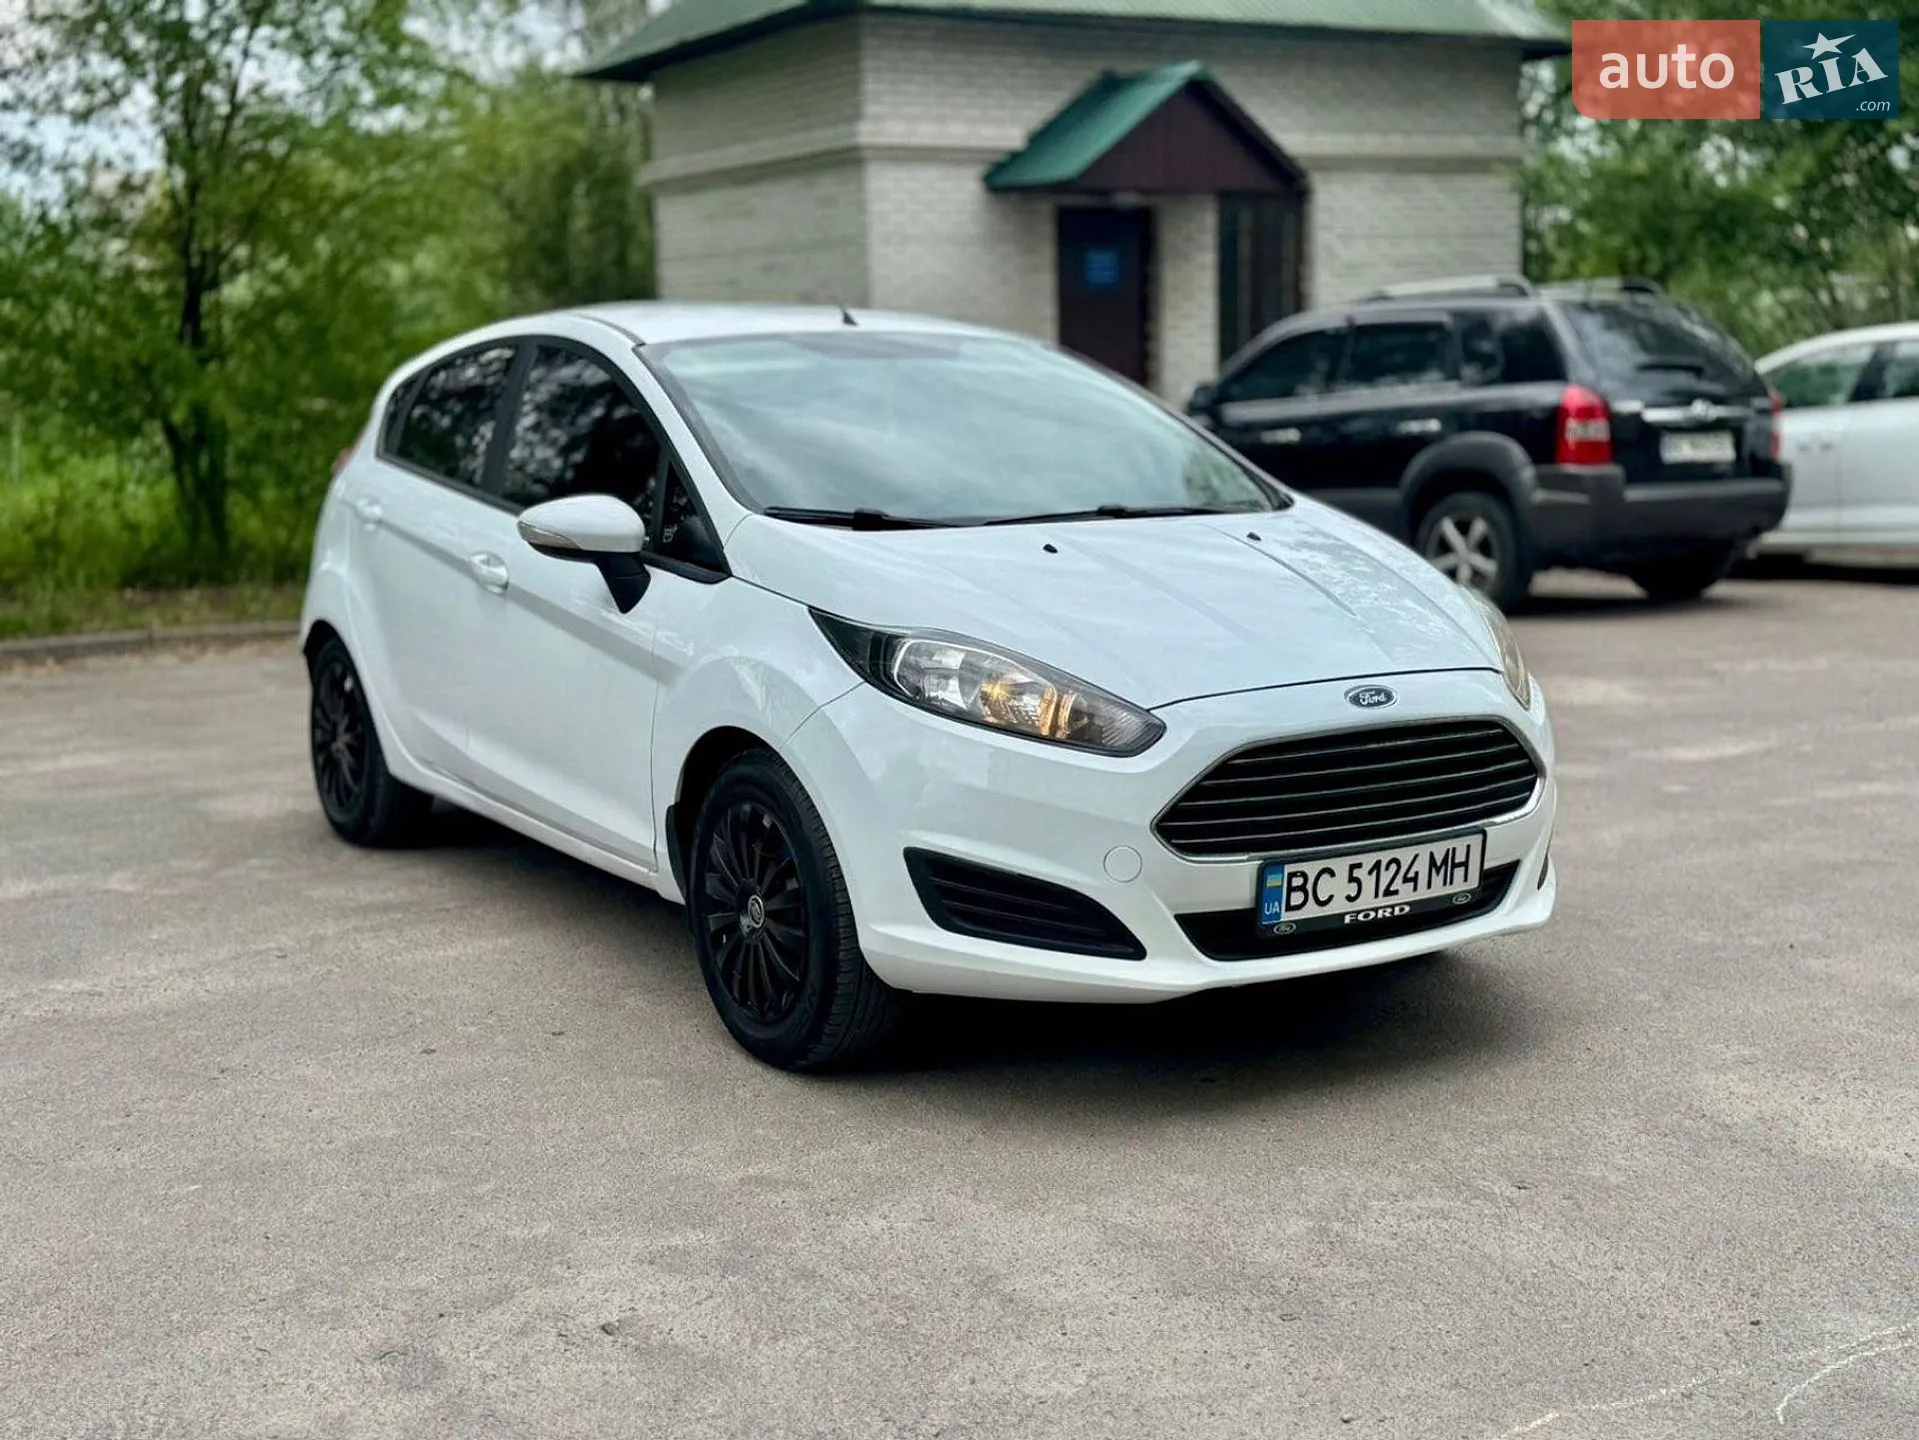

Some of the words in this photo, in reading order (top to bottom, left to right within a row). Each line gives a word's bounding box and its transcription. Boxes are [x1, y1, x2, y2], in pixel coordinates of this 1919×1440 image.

[1359, 690, 1388, 705] Ford
[1284, 866, 1337, 912] BC
[1344, 852, 1420, 903] 5124
[1427, 843, 1471, 890] MH
[1264, 901, 1280, 915] UA
[1344, 904, 1411, 924] FORD
